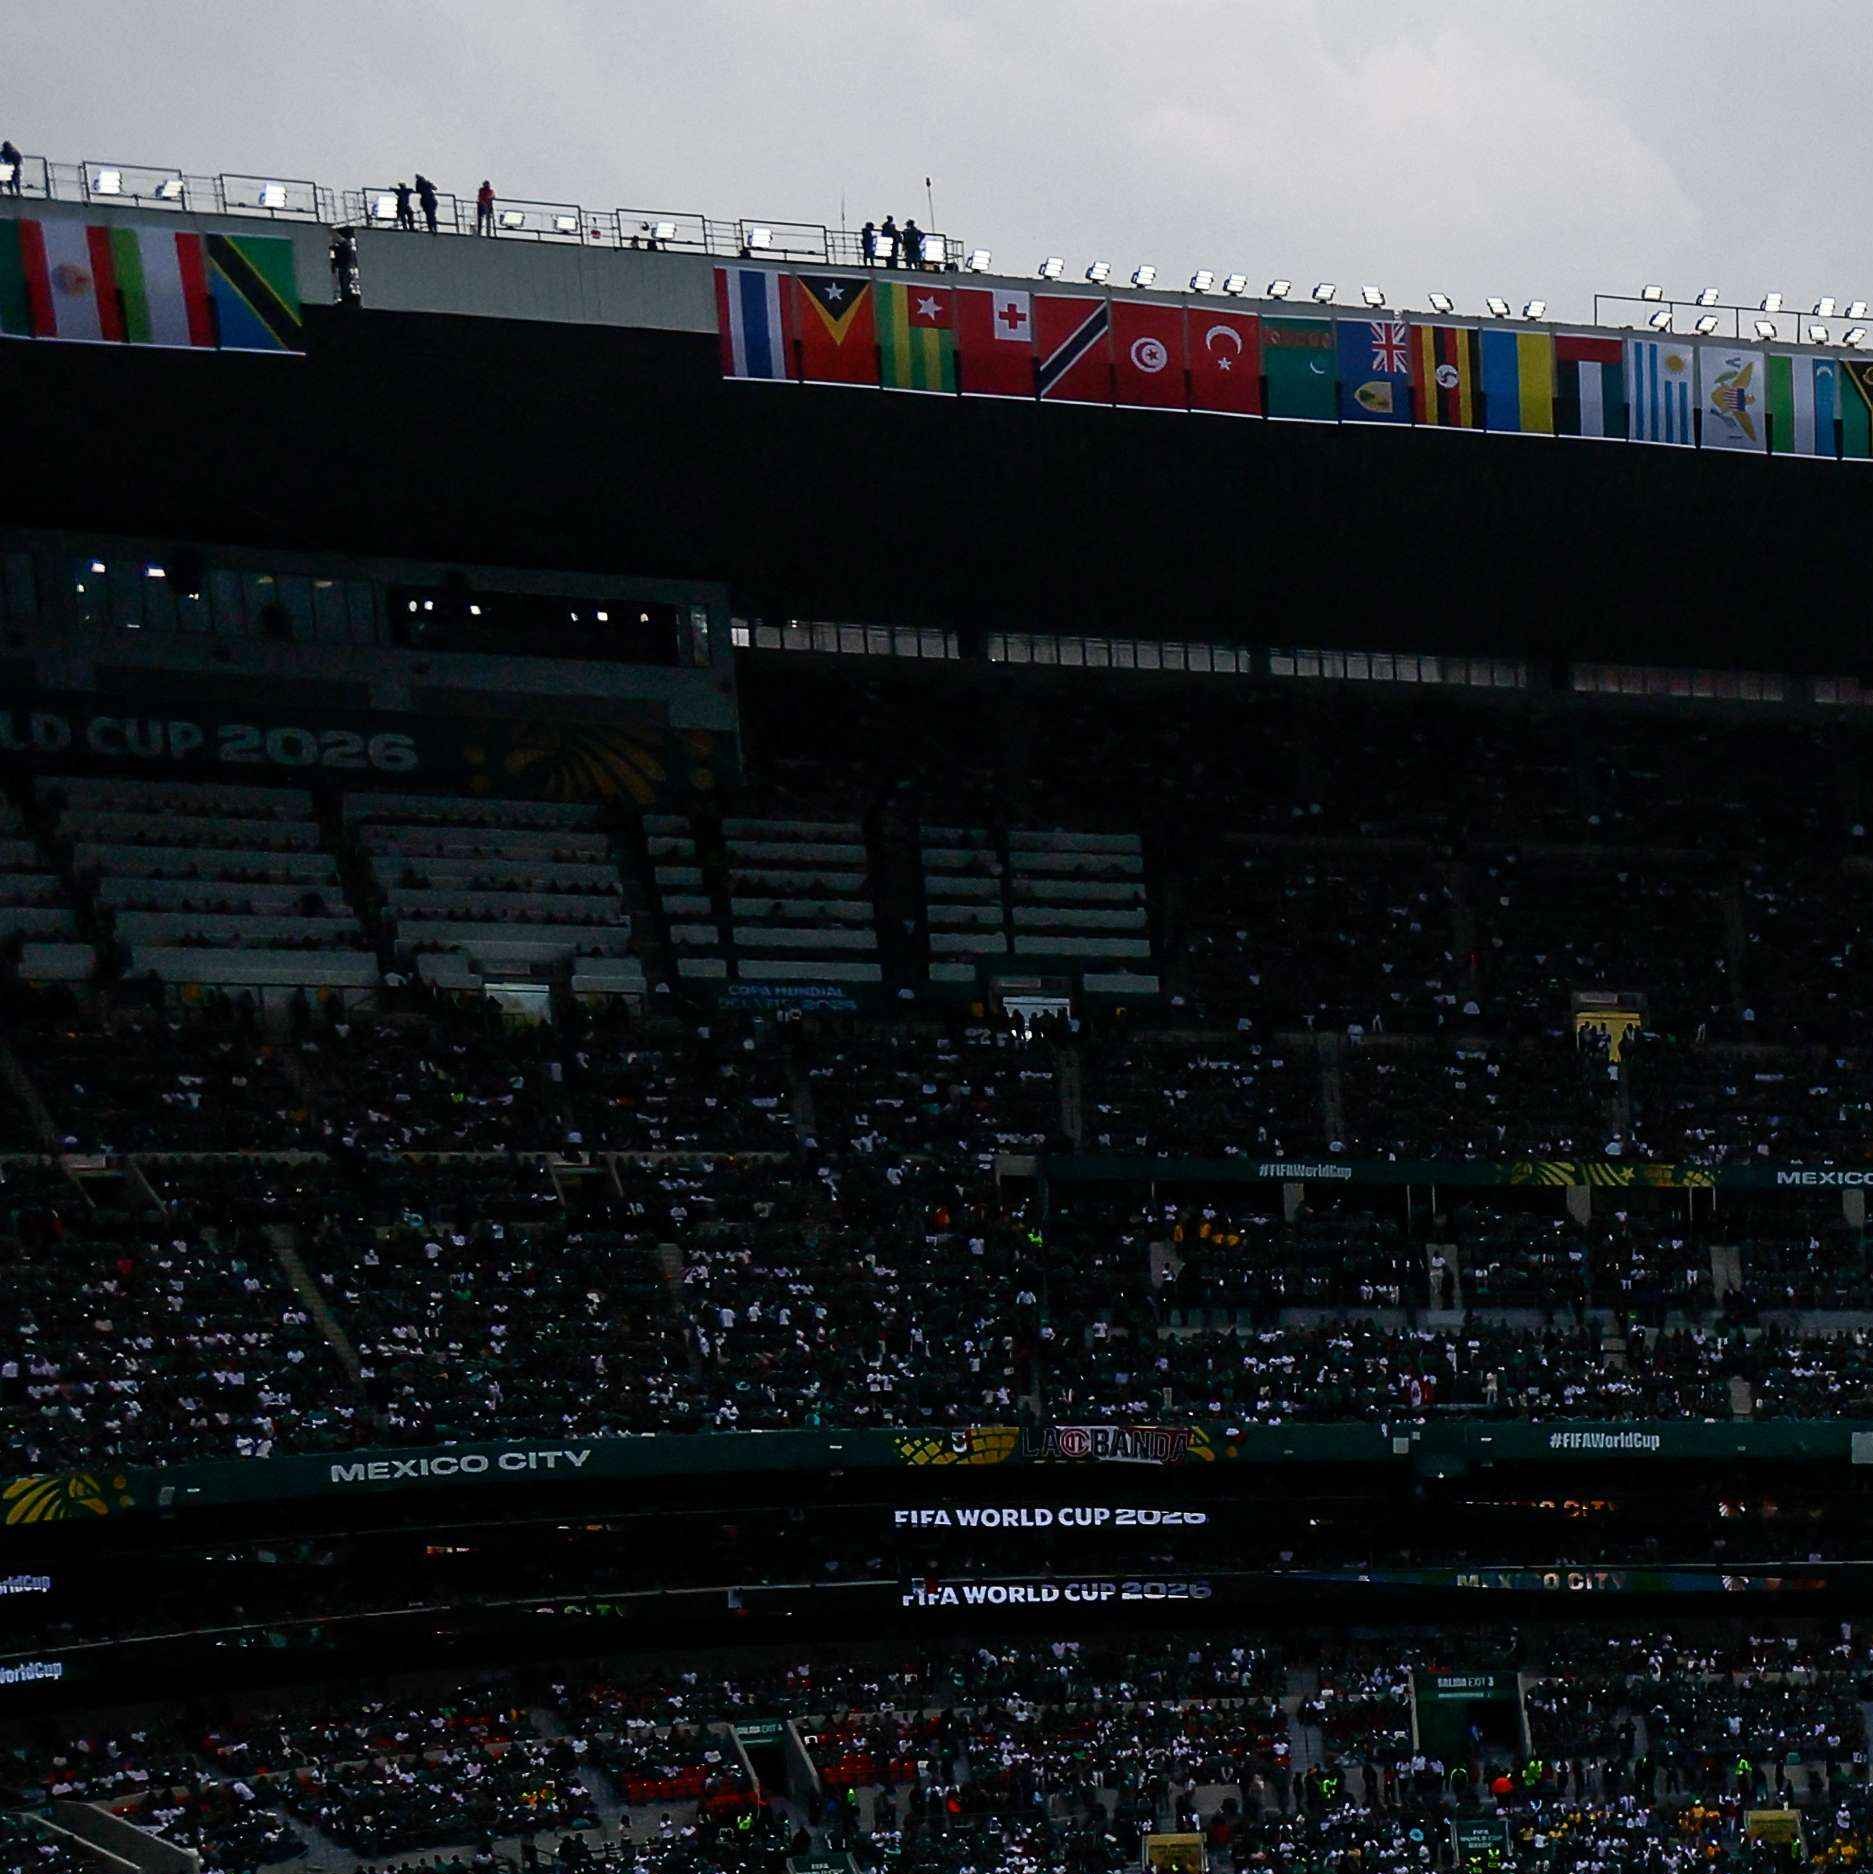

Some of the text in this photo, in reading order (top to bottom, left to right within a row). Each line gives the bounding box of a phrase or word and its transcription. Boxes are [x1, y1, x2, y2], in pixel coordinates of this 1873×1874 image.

[86, 715, 206, 760] CUP
[218, 724, 419, 774] 2026
[1550, 1432, 1660, 1451] #FIFAWorldCup
[330, 1449, 592, 1483] MEXICO CITY
[894, 1506, 1208, 1528] FIFA WORLD CUP 2026
[962, 1585, 1060, 1605] WORLD
[1064, 1582, 1118, 1602] CUP
